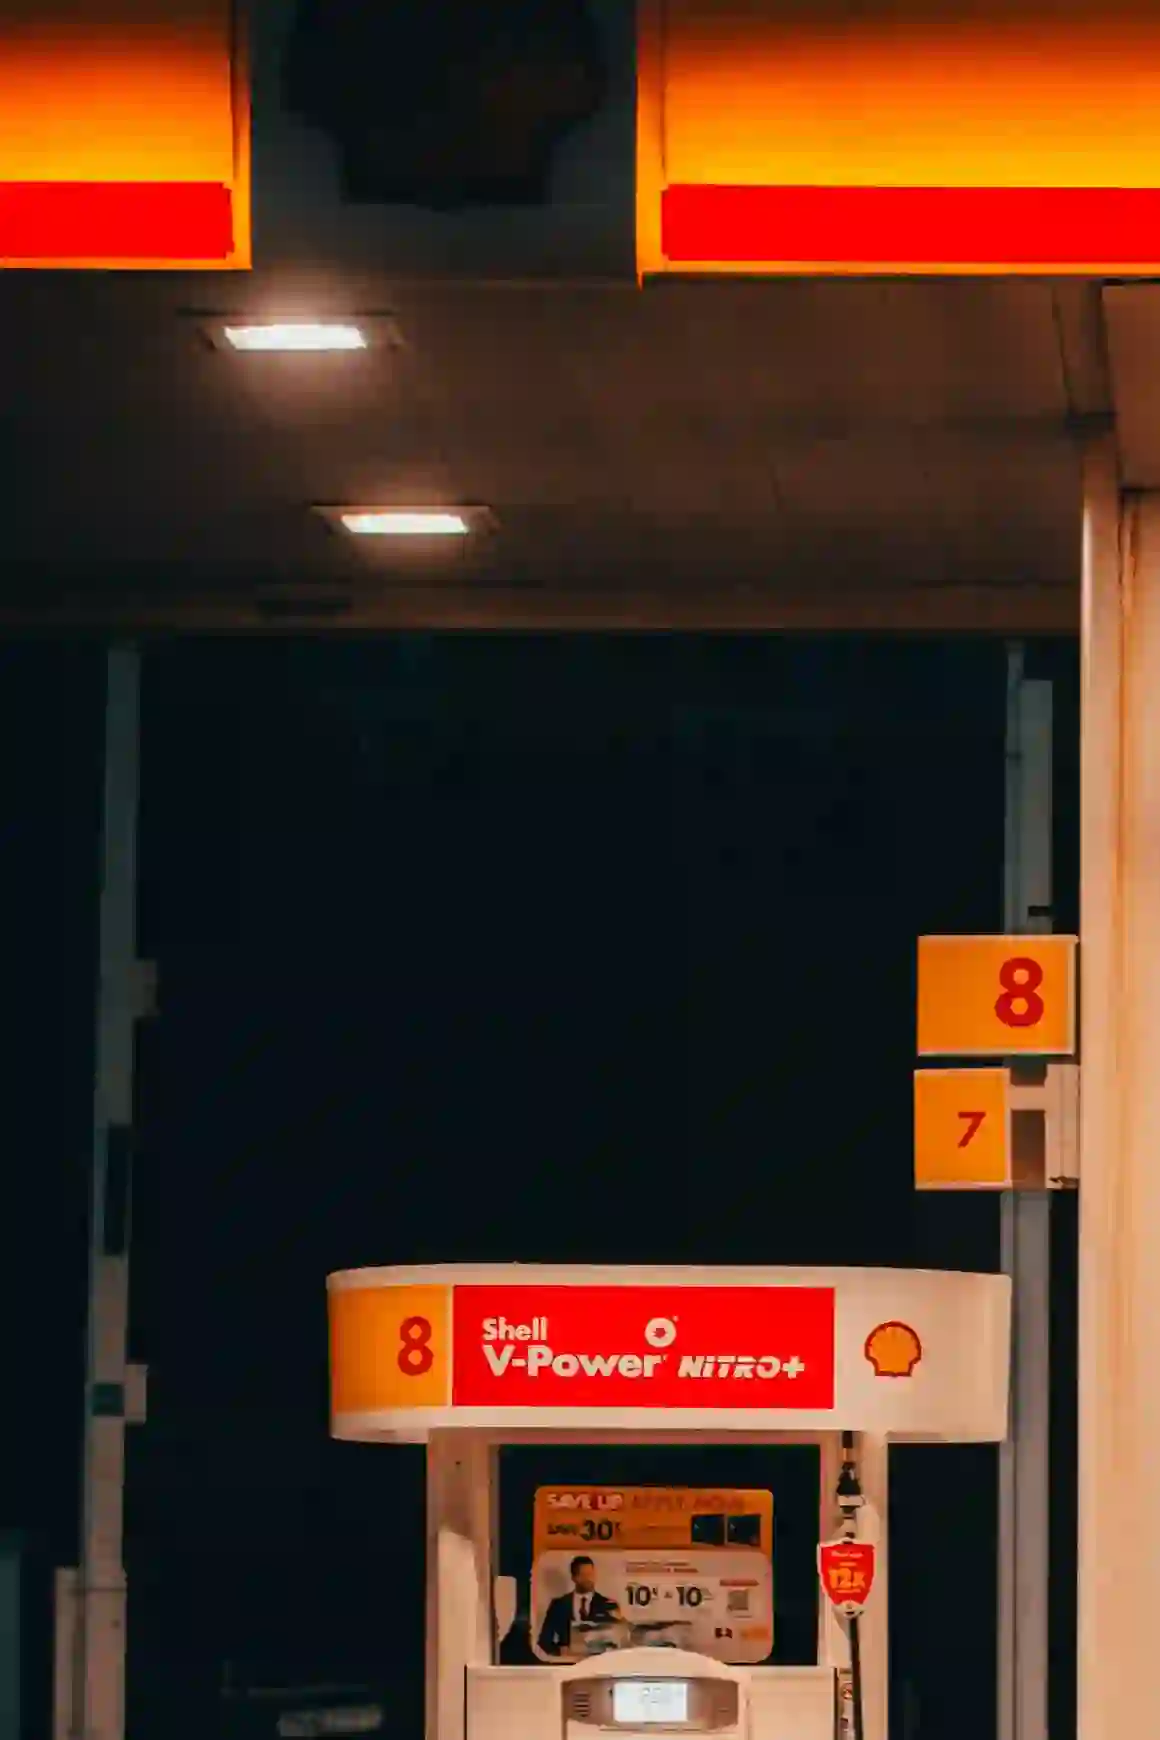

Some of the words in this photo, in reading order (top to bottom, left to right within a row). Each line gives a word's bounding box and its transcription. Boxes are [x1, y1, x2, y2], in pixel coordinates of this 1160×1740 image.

[994, 957, 1044, 1027] 8
[957, 1111, 987, 1148] 7
[482, 1316, 548, 1341] Shell
[397, 1316, 434, 1377] 8
[482, 1344, 663, 1378] V-Power
[547, 1493, 592, 1511] SAVE
